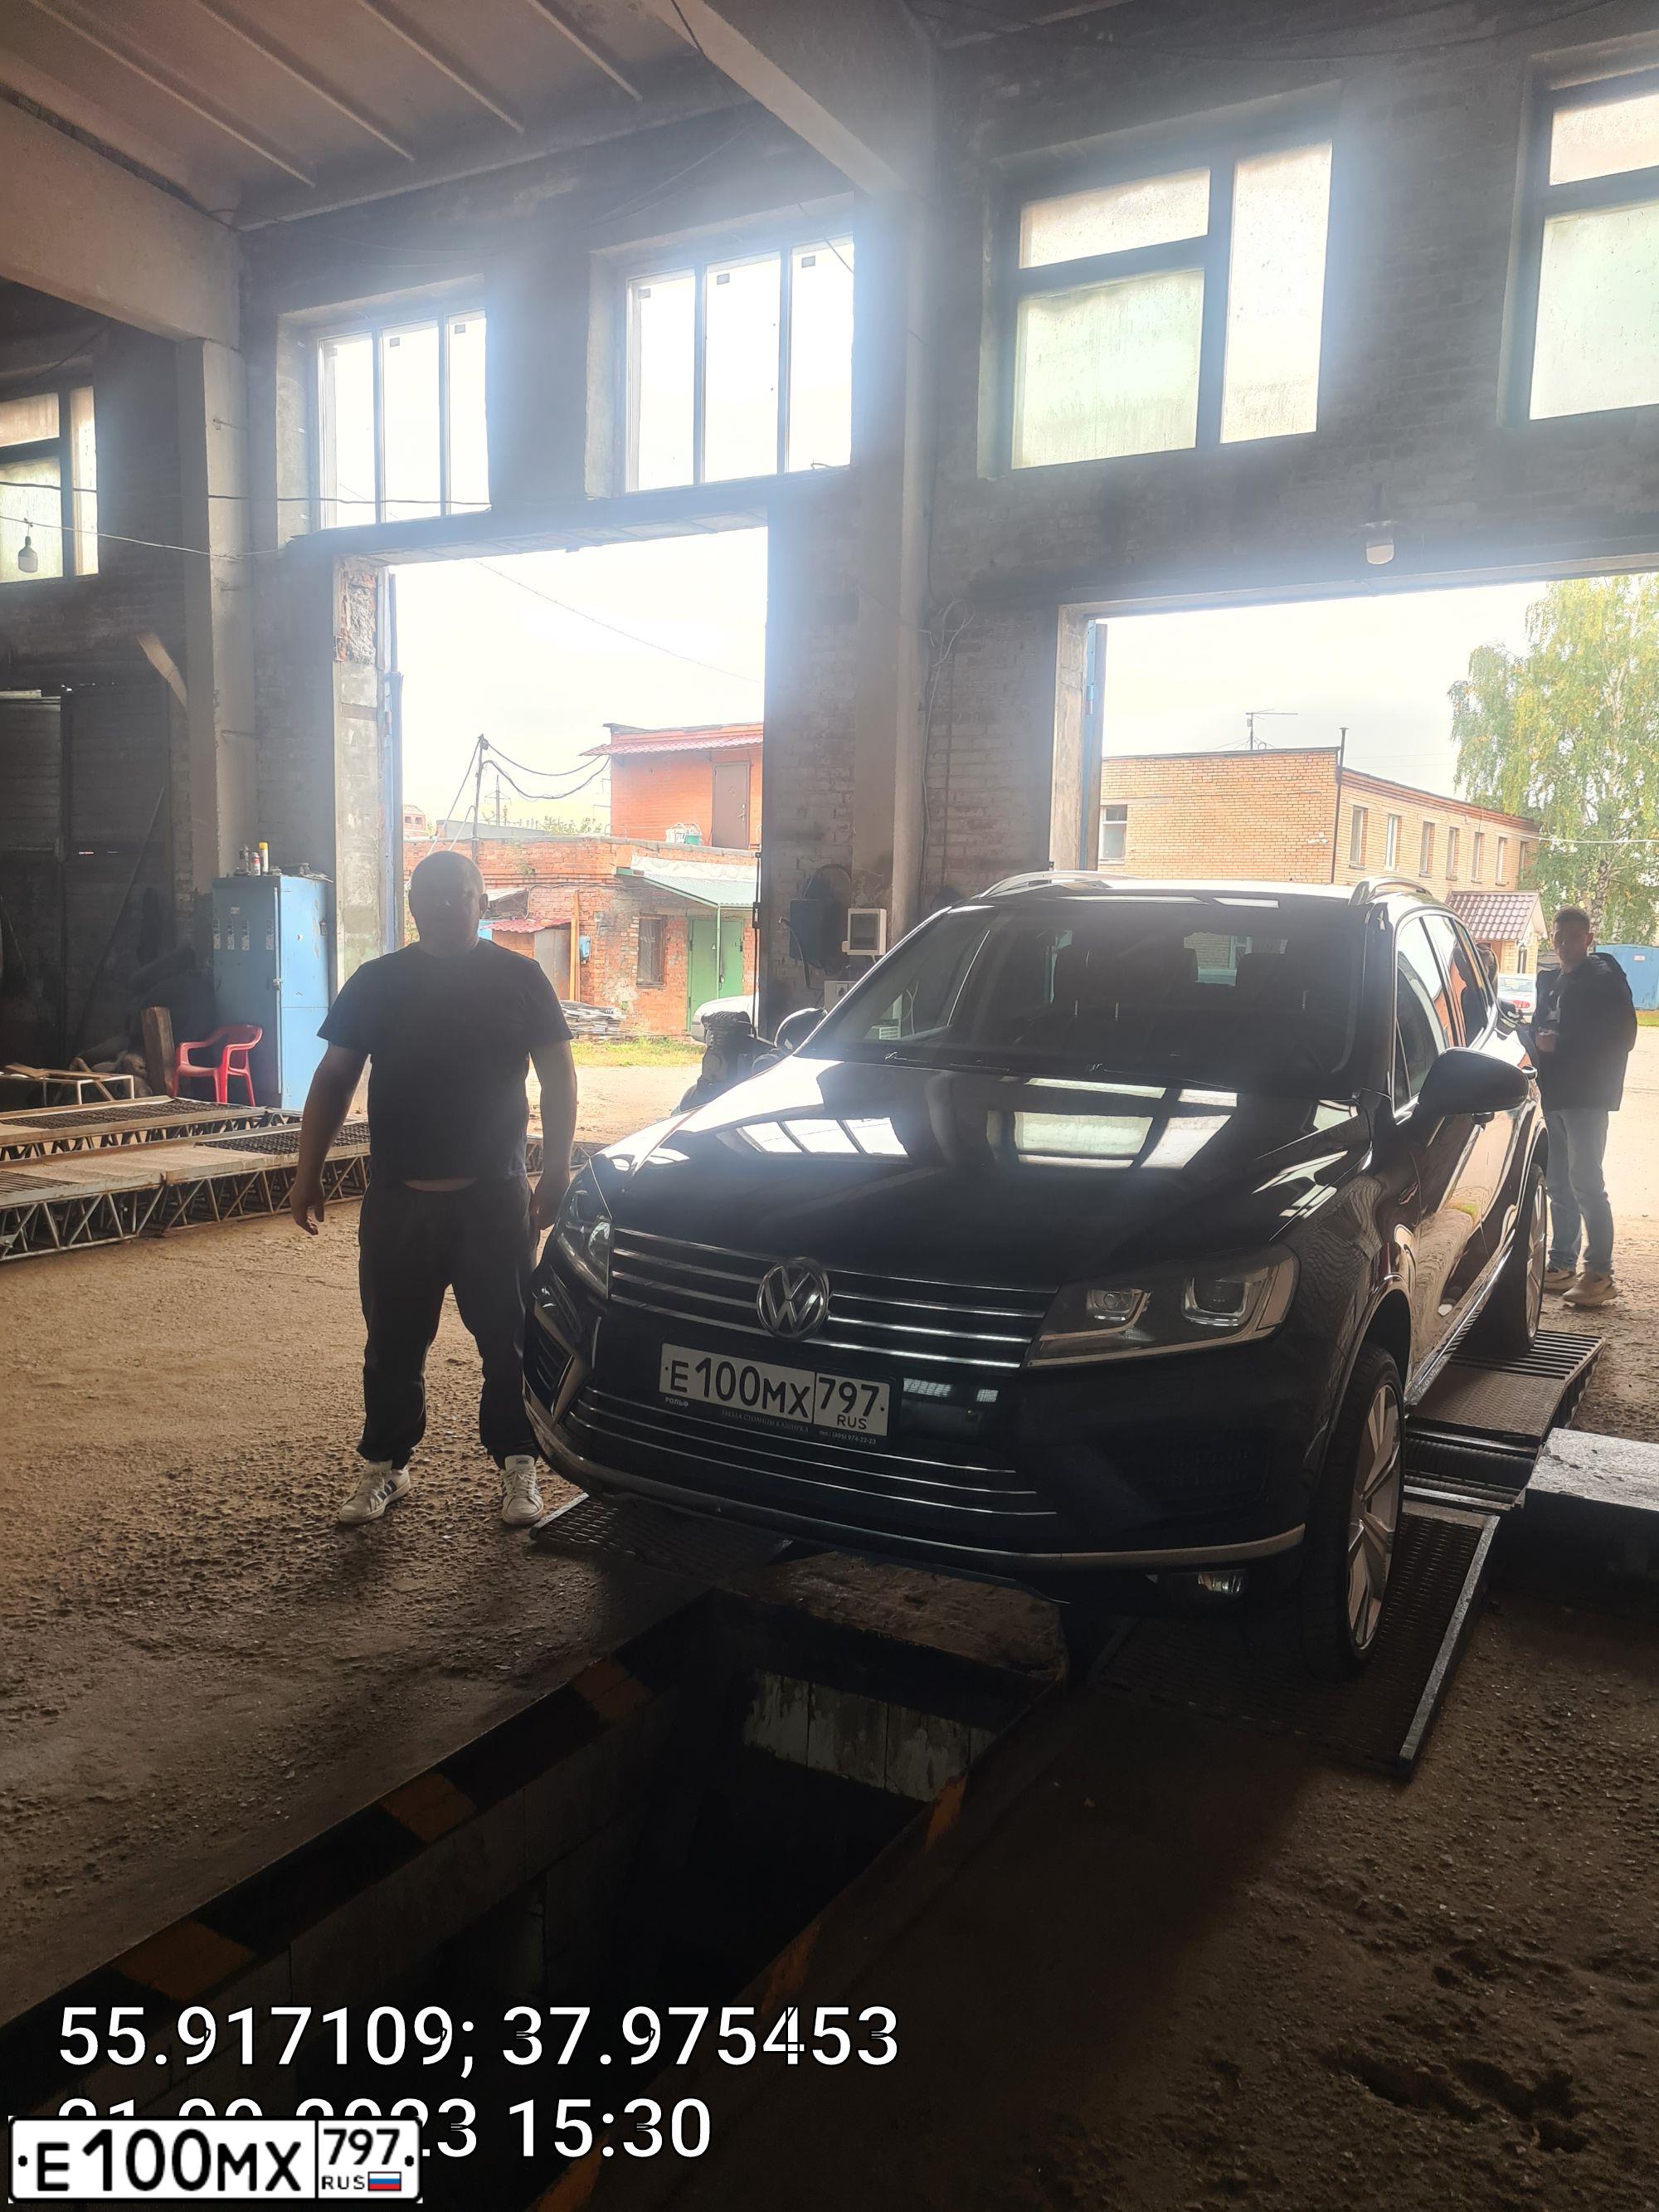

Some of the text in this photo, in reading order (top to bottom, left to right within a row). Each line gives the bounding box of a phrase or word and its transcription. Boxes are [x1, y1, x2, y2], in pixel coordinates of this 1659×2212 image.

[669, 1357, 879, 1419] Е100МХ 797
[837, 1414, 868, 1430] RUS
